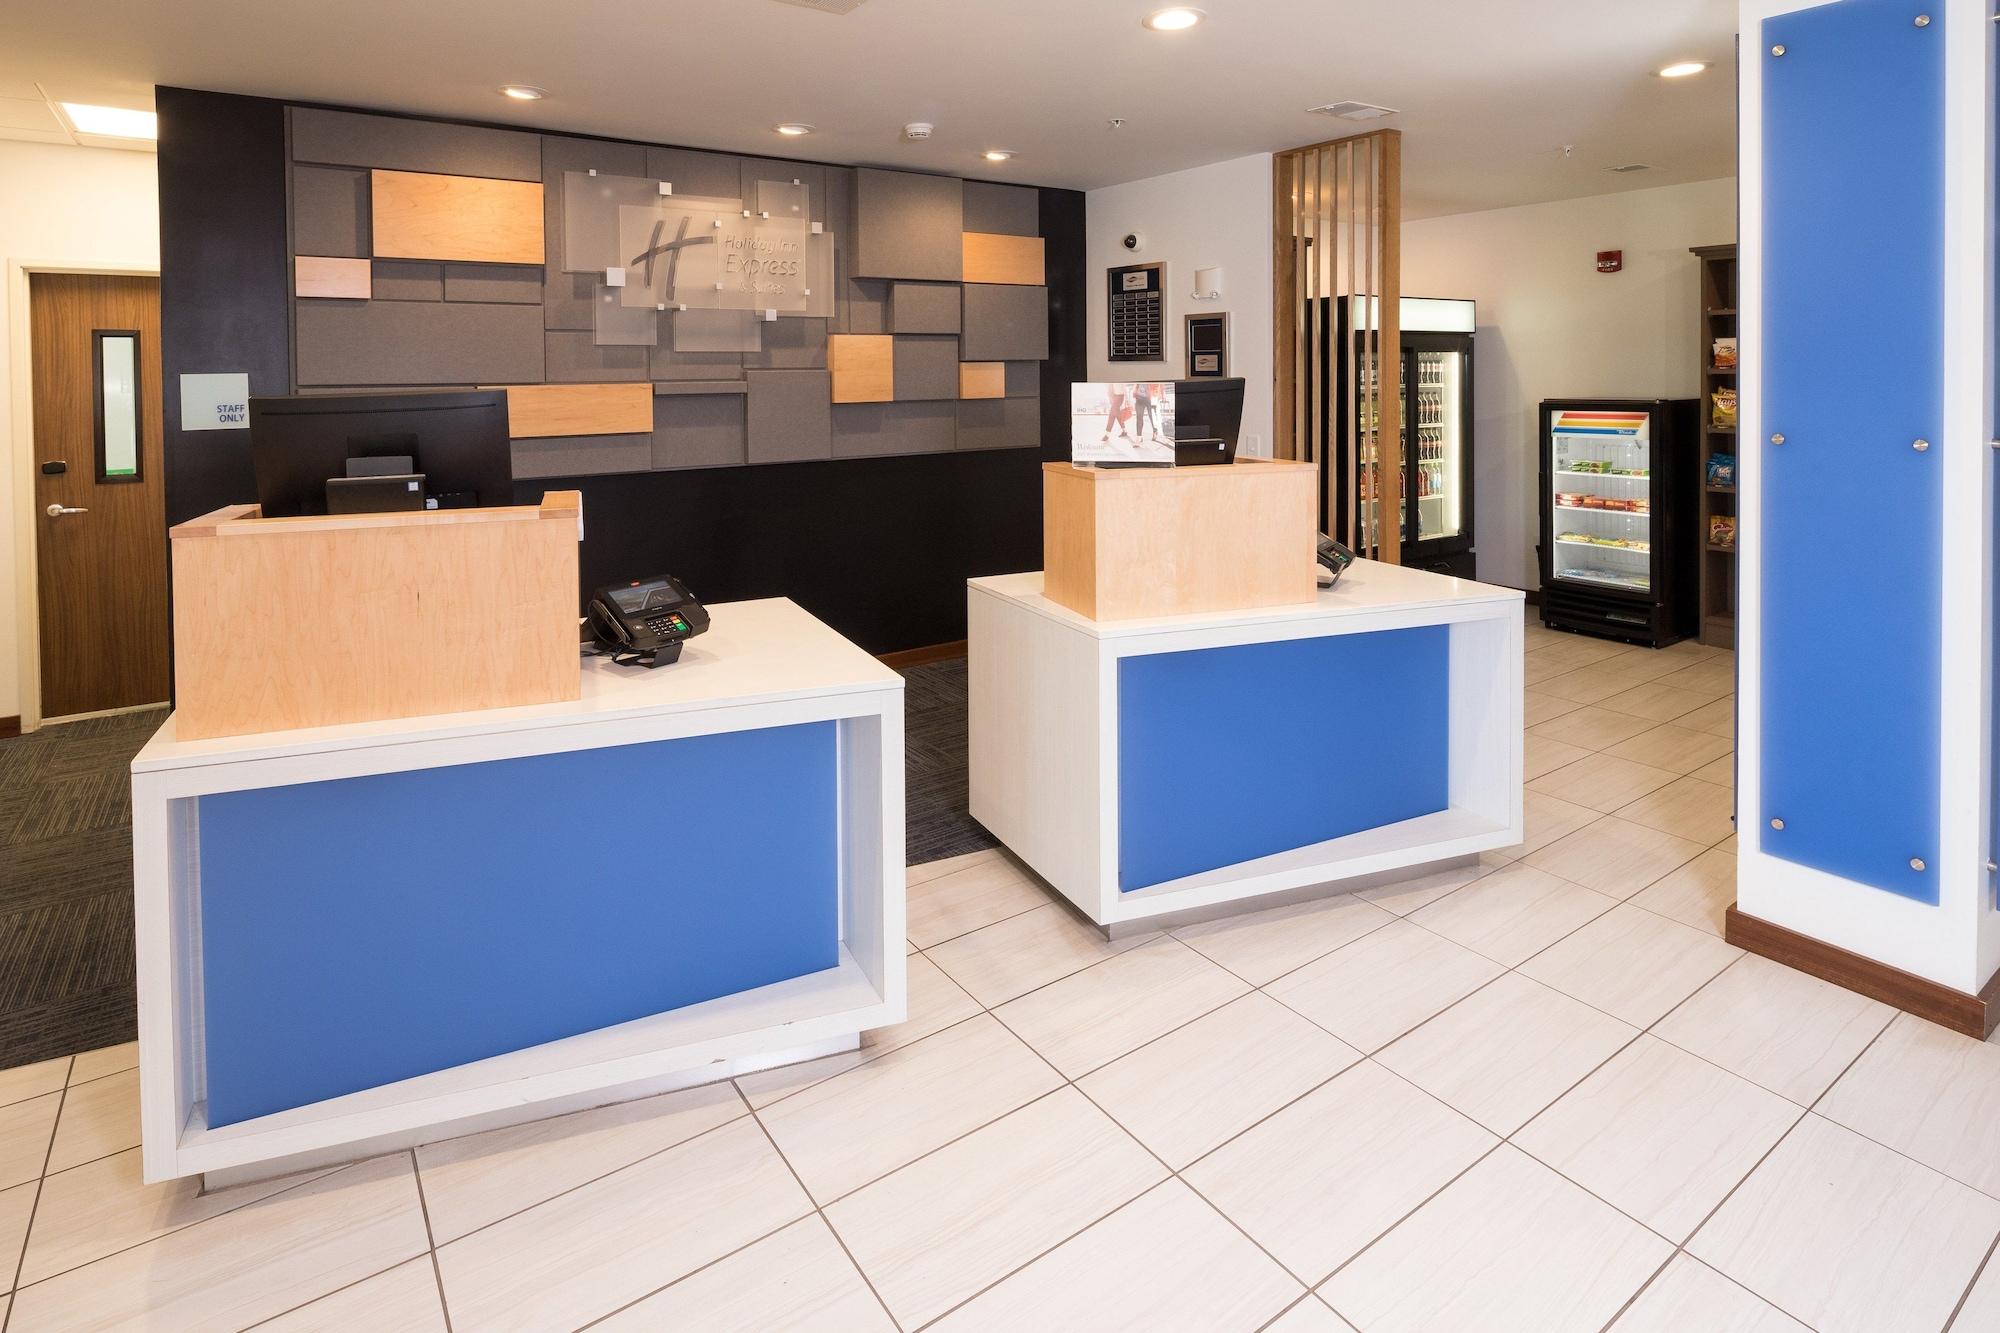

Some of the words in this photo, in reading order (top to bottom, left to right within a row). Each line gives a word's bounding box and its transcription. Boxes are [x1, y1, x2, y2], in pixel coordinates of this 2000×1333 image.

[725, 235, 776, 255] Holiday
[779, 239, 798, 251] Inn
[726, 254, 798, 278] Express
[216, 404, 245, 413] STAFF
[219, 413, 245, 423] ONLY
